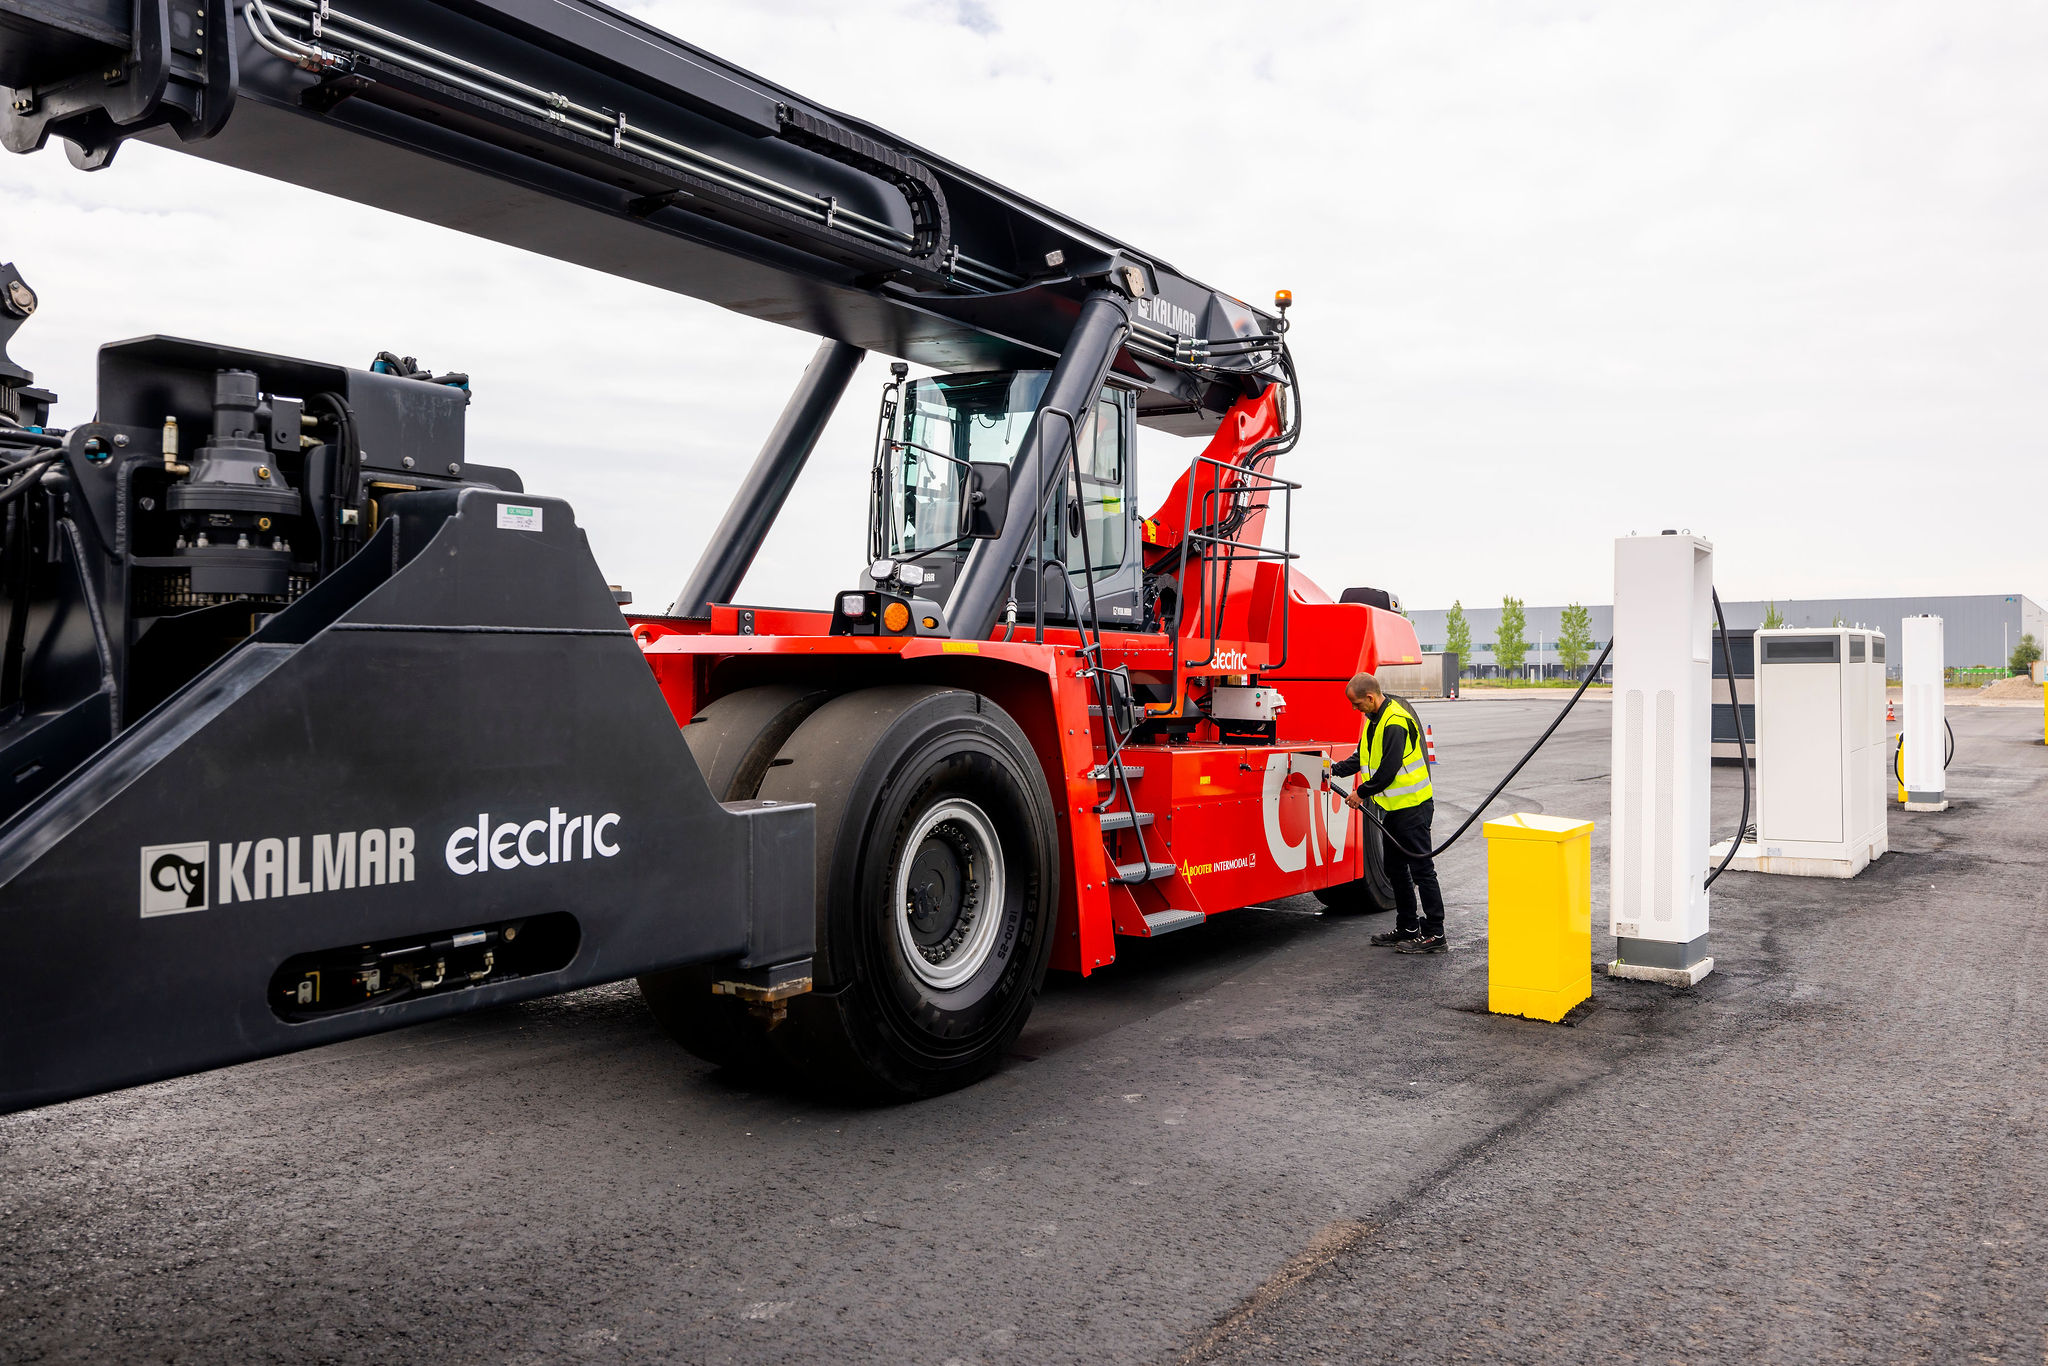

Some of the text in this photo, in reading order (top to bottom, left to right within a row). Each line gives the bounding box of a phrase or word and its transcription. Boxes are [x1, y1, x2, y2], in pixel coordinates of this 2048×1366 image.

[1153, 297, 1196, 338] KALMAR
[1211, 648, 1247, 670] electric
[219, 807, 621, 904] KALMAR electric
[1213, 857, 1249, 873] INTERMODAL
[997, 910, 1018, 960] 18.00-25
